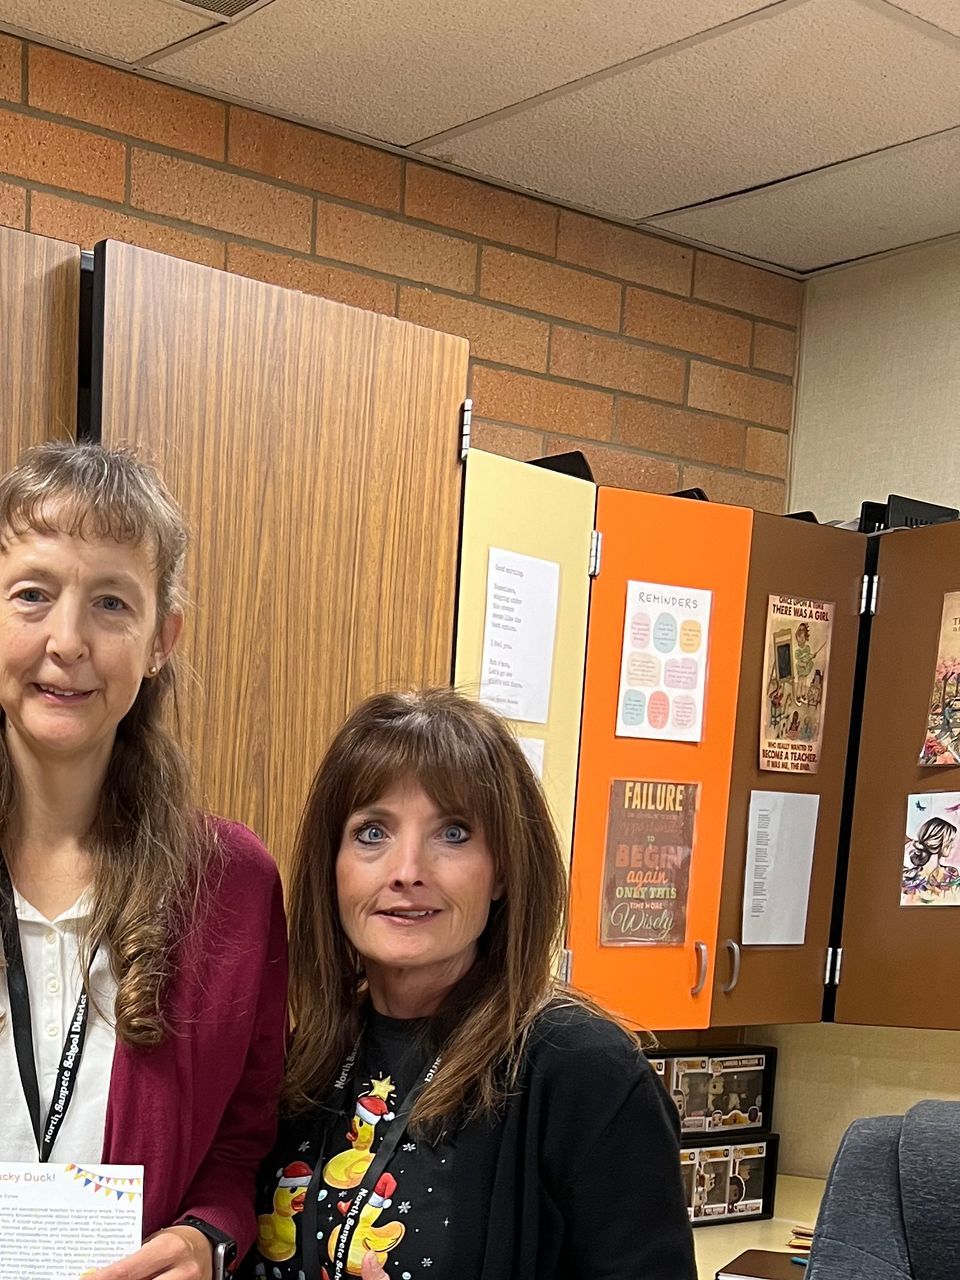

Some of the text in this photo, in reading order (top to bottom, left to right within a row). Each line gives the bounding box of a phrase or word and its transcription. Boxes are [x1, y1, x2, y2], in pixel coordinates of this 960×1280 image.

[638, 591, 698, 609] REMINDERS
[772, 604, 829, 621] THERE WAS A GIRL
[762, 749, 783, 760] BECOME
[784, 752, 789, 760] A
[624, 781, 684, 812] FAILURE
[647, 835, 655, 843] TO
[615, 843, 684, 869] BEGIN
[626, 866, 669, 890] again
[616, 886, 677, 899] ONLY THIS
[645, 902, 663, 910] MORE
[610, 902, 674, 938] Wisely
[44, 994, 88, 1143] North Sanpete School District
[334, 1062, 355, 1089] North
[24, 1172, 56, 1183] Duck!
[346, 1187, 369, 1218] North
[336, 1217, 355, 1258] Sanpete
